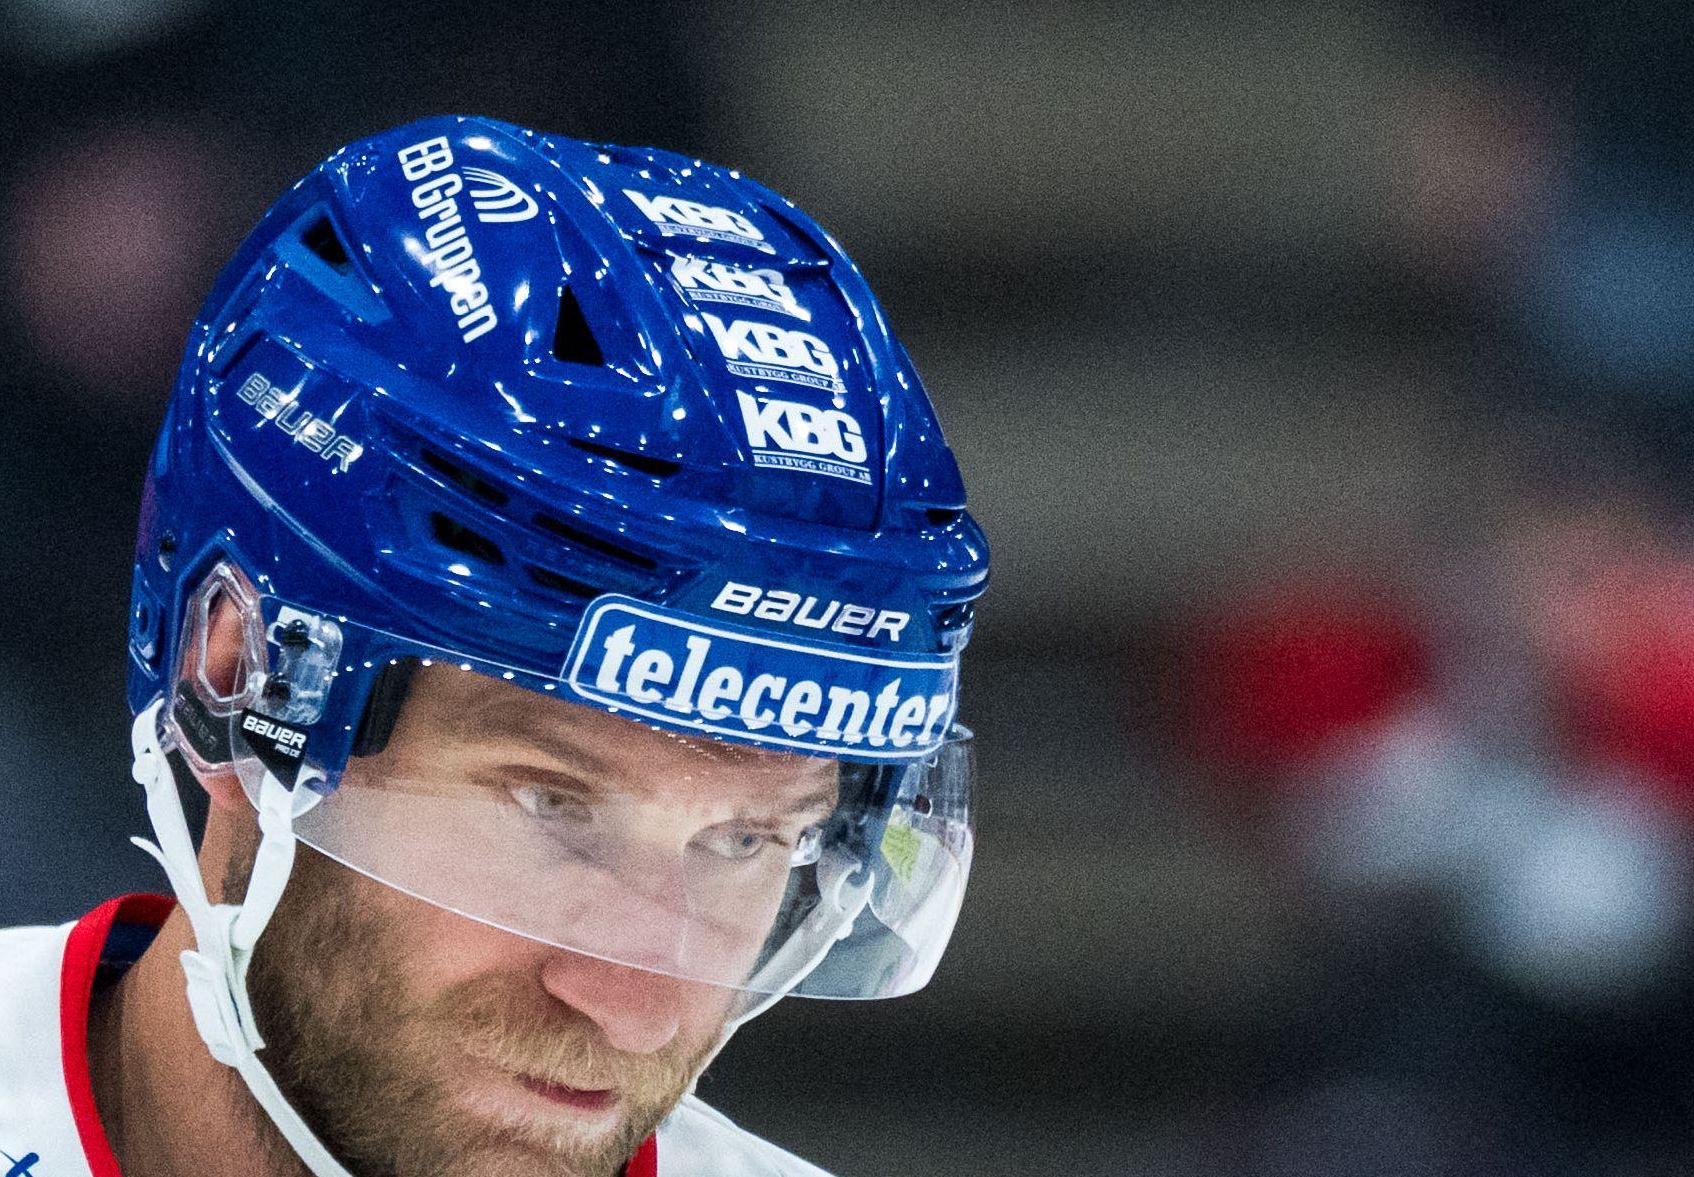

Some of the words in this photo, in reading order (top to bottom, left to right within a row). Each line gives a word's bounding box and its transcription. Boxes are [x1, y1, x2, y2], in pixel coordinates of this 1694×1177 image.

[397, 136, 454, 182] EB
[621, 188, 764, 241] KBG
[411, 173, 498, 344] Gruppen
[665, 249, 797, 309] KBG
[701, 312, 839, 377] KBG
[736, 389, 868, 463] KBG
[755, 455, 817, 470] KUSTBYGG
[818, 463, 856, 478] GROUP
[595, 623, 950, 748] telecenter
